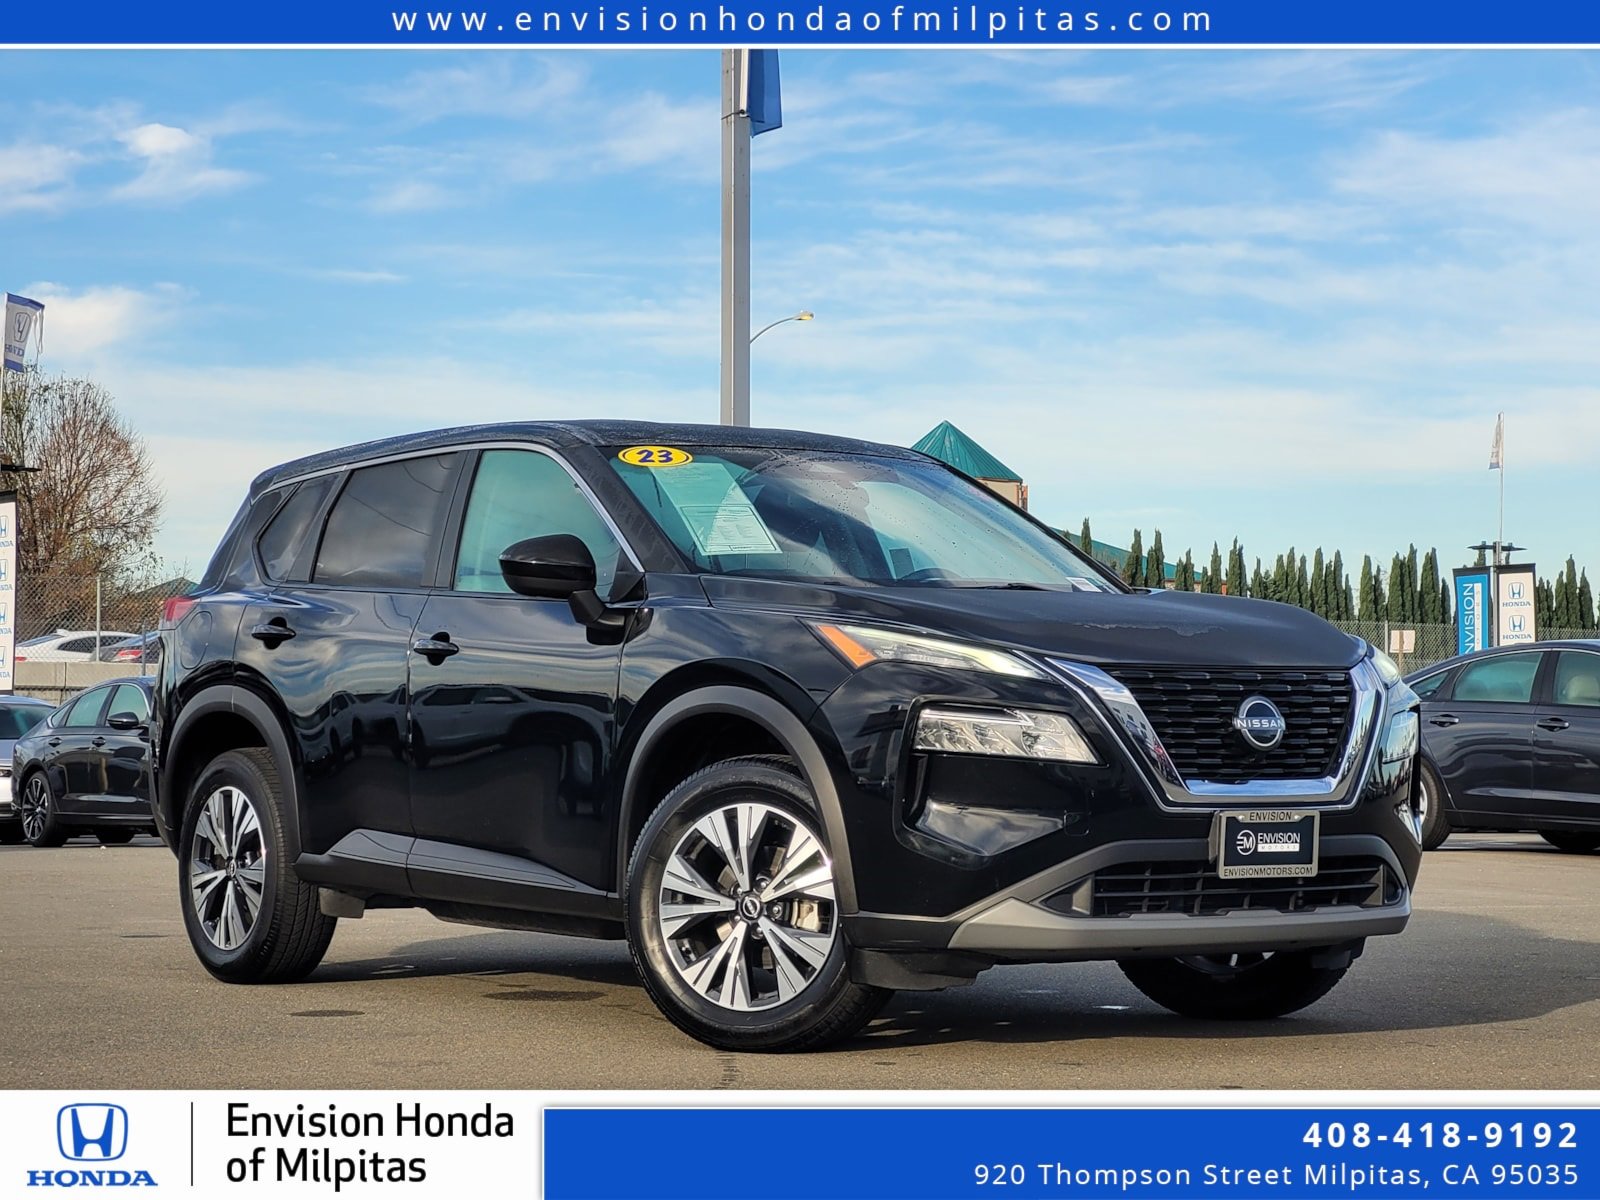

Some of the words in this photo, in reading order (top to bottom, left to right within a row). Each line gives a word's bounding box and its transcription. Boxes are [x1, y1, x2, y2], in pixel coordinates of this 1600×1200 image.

[636, 449, 674, 463] 23
[1463, 584, 1474, 654] NVISION
[1237, 719, 1285, 728] NISSAN
[1249, 811, 1292, 821] ENVISION
[1257, 832, 1300, 843] ENVISION
[1223, 867, 1313, 877] ENVISIONMOTORS.COM
